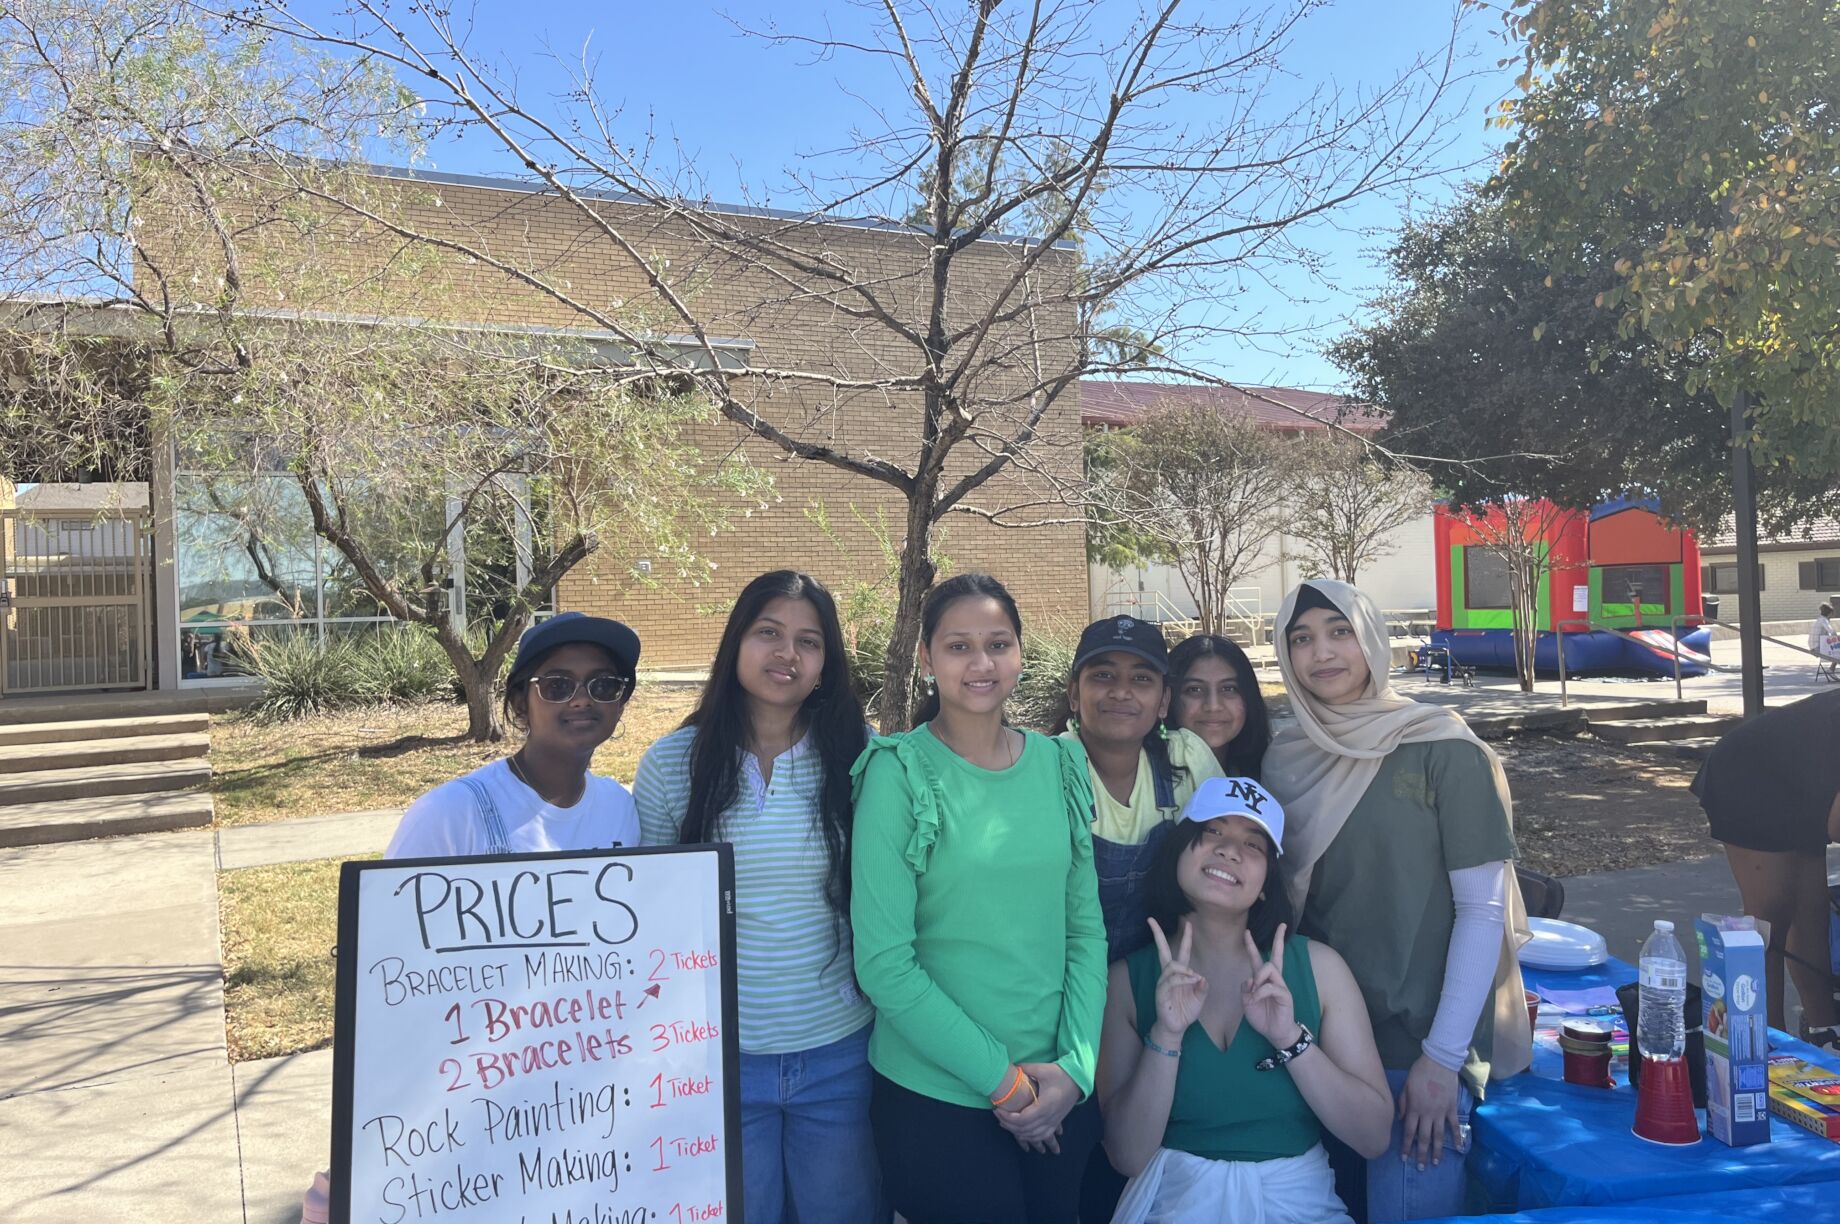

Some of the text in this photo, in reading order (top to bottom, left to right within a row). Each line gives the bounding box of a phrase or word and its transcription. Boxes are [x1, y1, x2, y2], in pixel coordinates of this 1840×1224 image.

[1225, 780, 1268, 815] NY
[394, 862, 639, 950] PRICES
[369, 949, 719, 1007] BRACELET MAKING: 2 Tickets
[444, 988, 628, 1046] 1 Bracelet
[438, 1020, 720, 1093] 2 Bracelets 3 Tickets
[362, 1072, 715, 1168] Rock Painting: 1 Ticket
[379, 1134, 720, 1224] Sticker Making: 1 Ticket
[685, 1200, 723, 1223] Ticket
